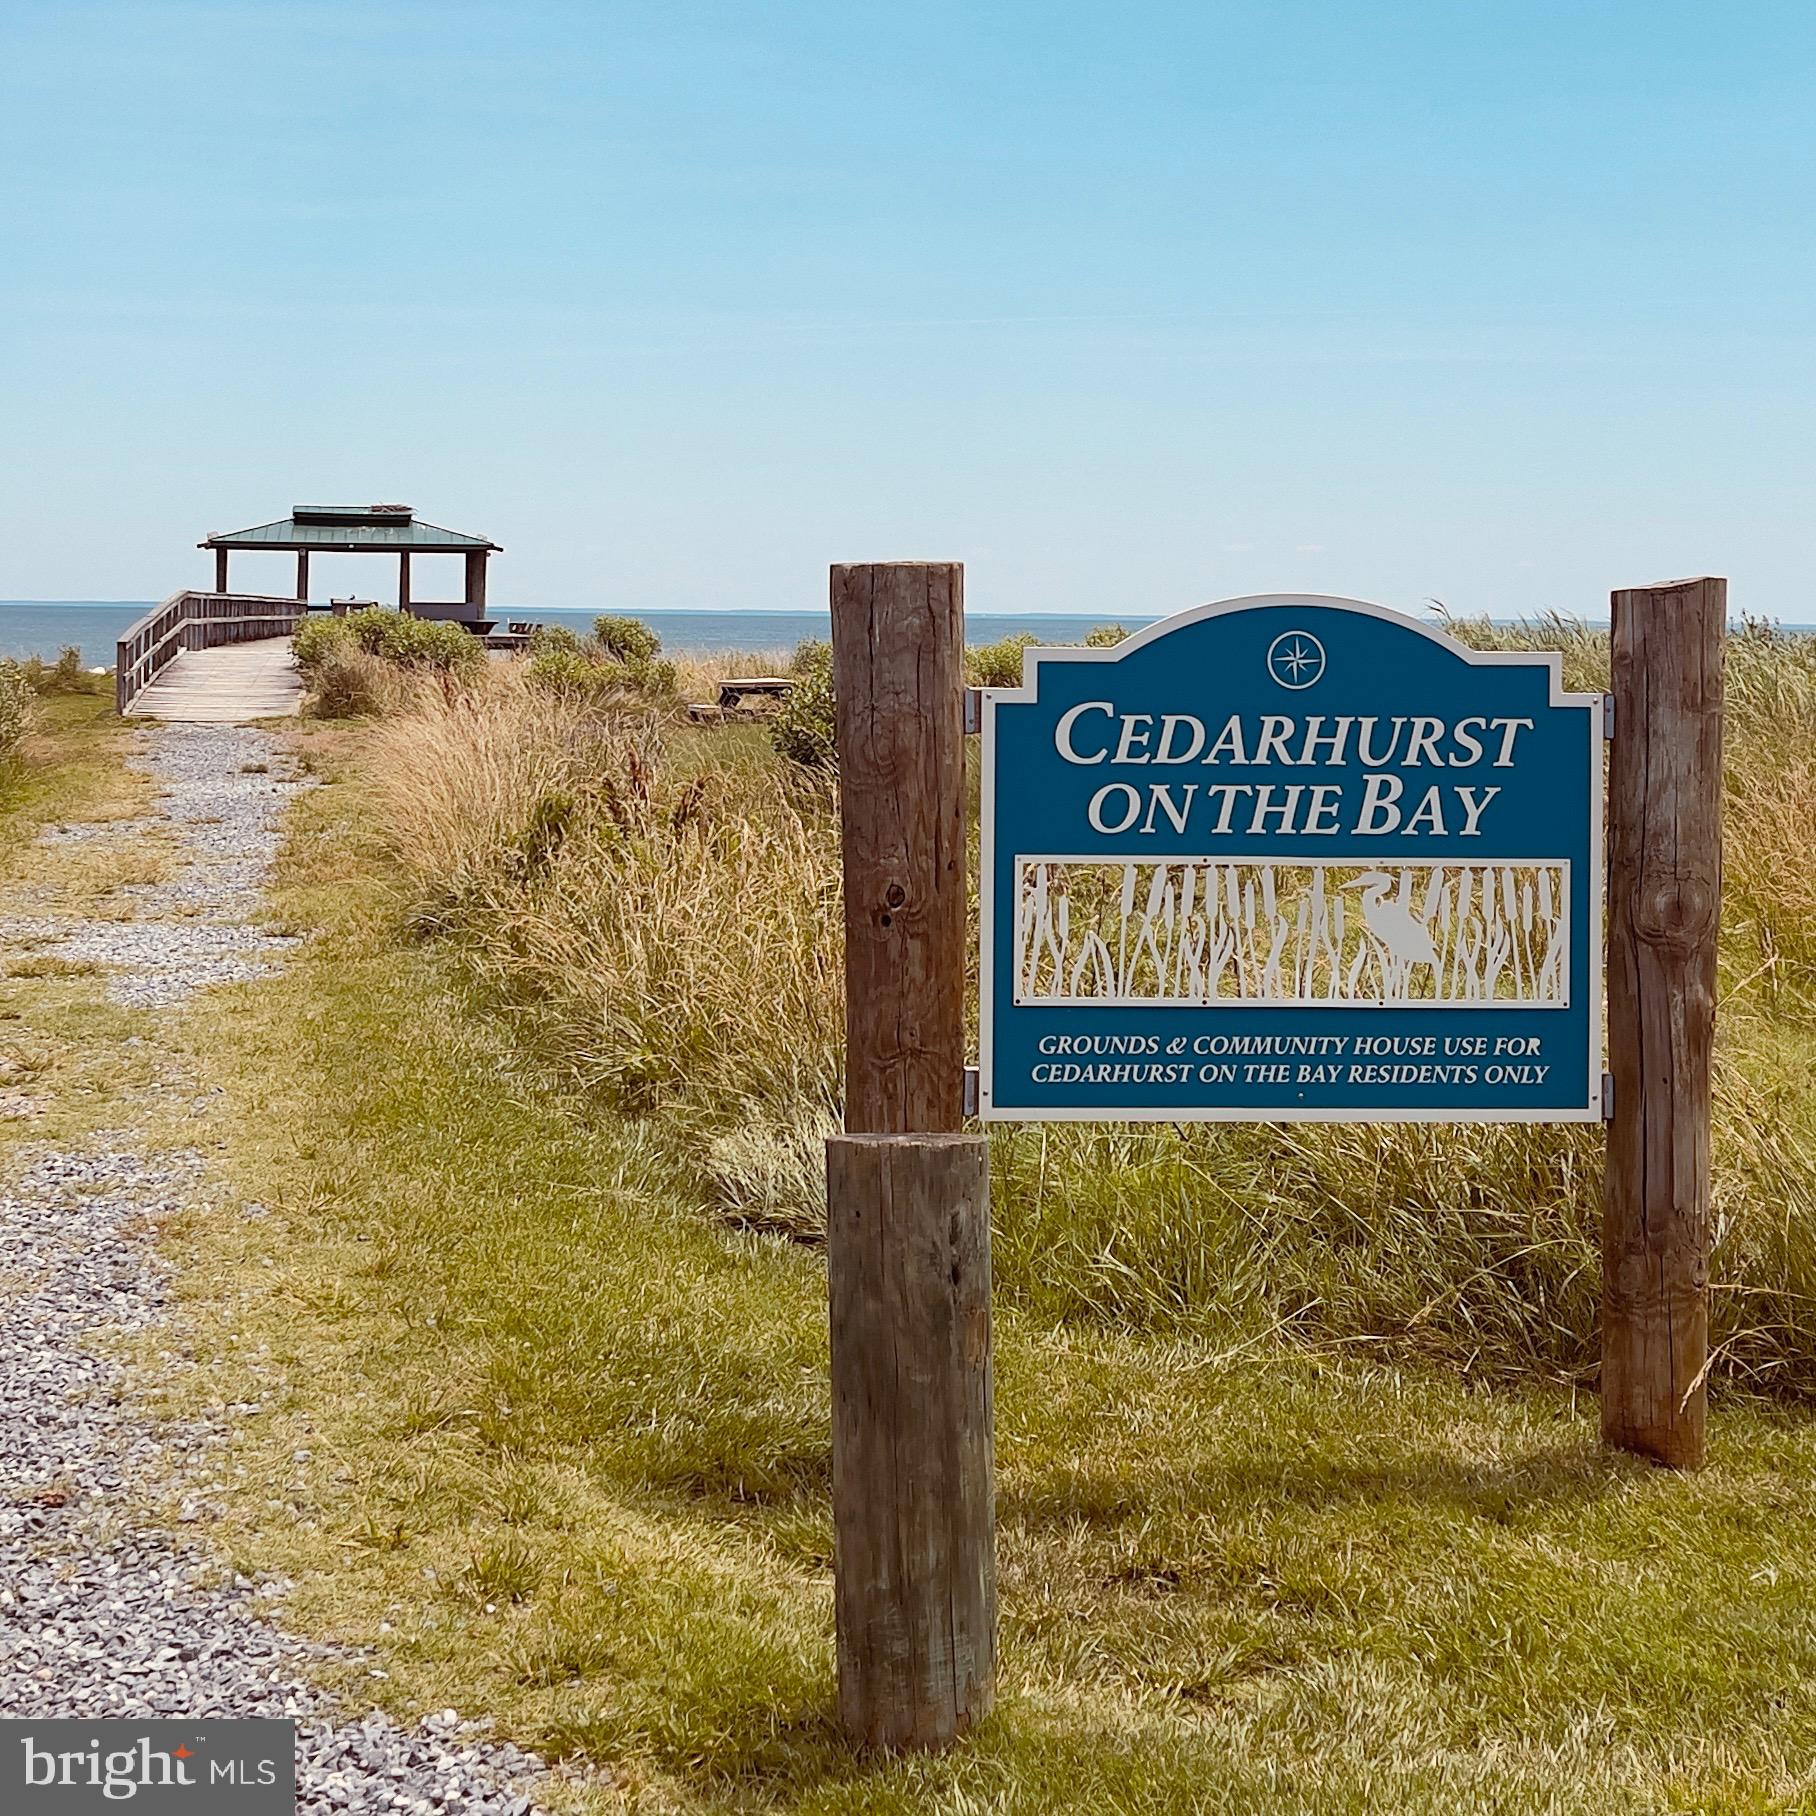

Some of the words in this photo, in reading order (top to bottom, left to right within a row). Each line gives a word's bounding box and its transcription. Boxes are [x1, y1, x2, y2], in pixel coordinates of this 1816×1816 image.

[1056, 702, 1533, 766] CEDARHURST
[1089, 784, 1198, 833] ON
[1209, 785, 1342, 834] THE
[1351, 774, 1501, 835] BAY
[1039, 1036, 1159, 1054] GROUNDS
[1166, 1037, 1187, 1054] &
[1194, 1036, 1349, 1054] COMMUNITY
[1354, 1037, 1436, 1055] HOUSE
[1445, 1038, 1487, 1055] USE
[1494, 1038, 1540, 1055] FOR
[1032, 1064, 1194, 1082] CEDARHURST
[1200, 1065, 1236, 1082] ON
[1244, 1065, 1290, 1082] THE
[1297, 1065, 1343, 1082] BAY
[1348, 1065, 1478, 1083] RESIDENTS
[1485, 1066, 1549, 1083] ONLY
